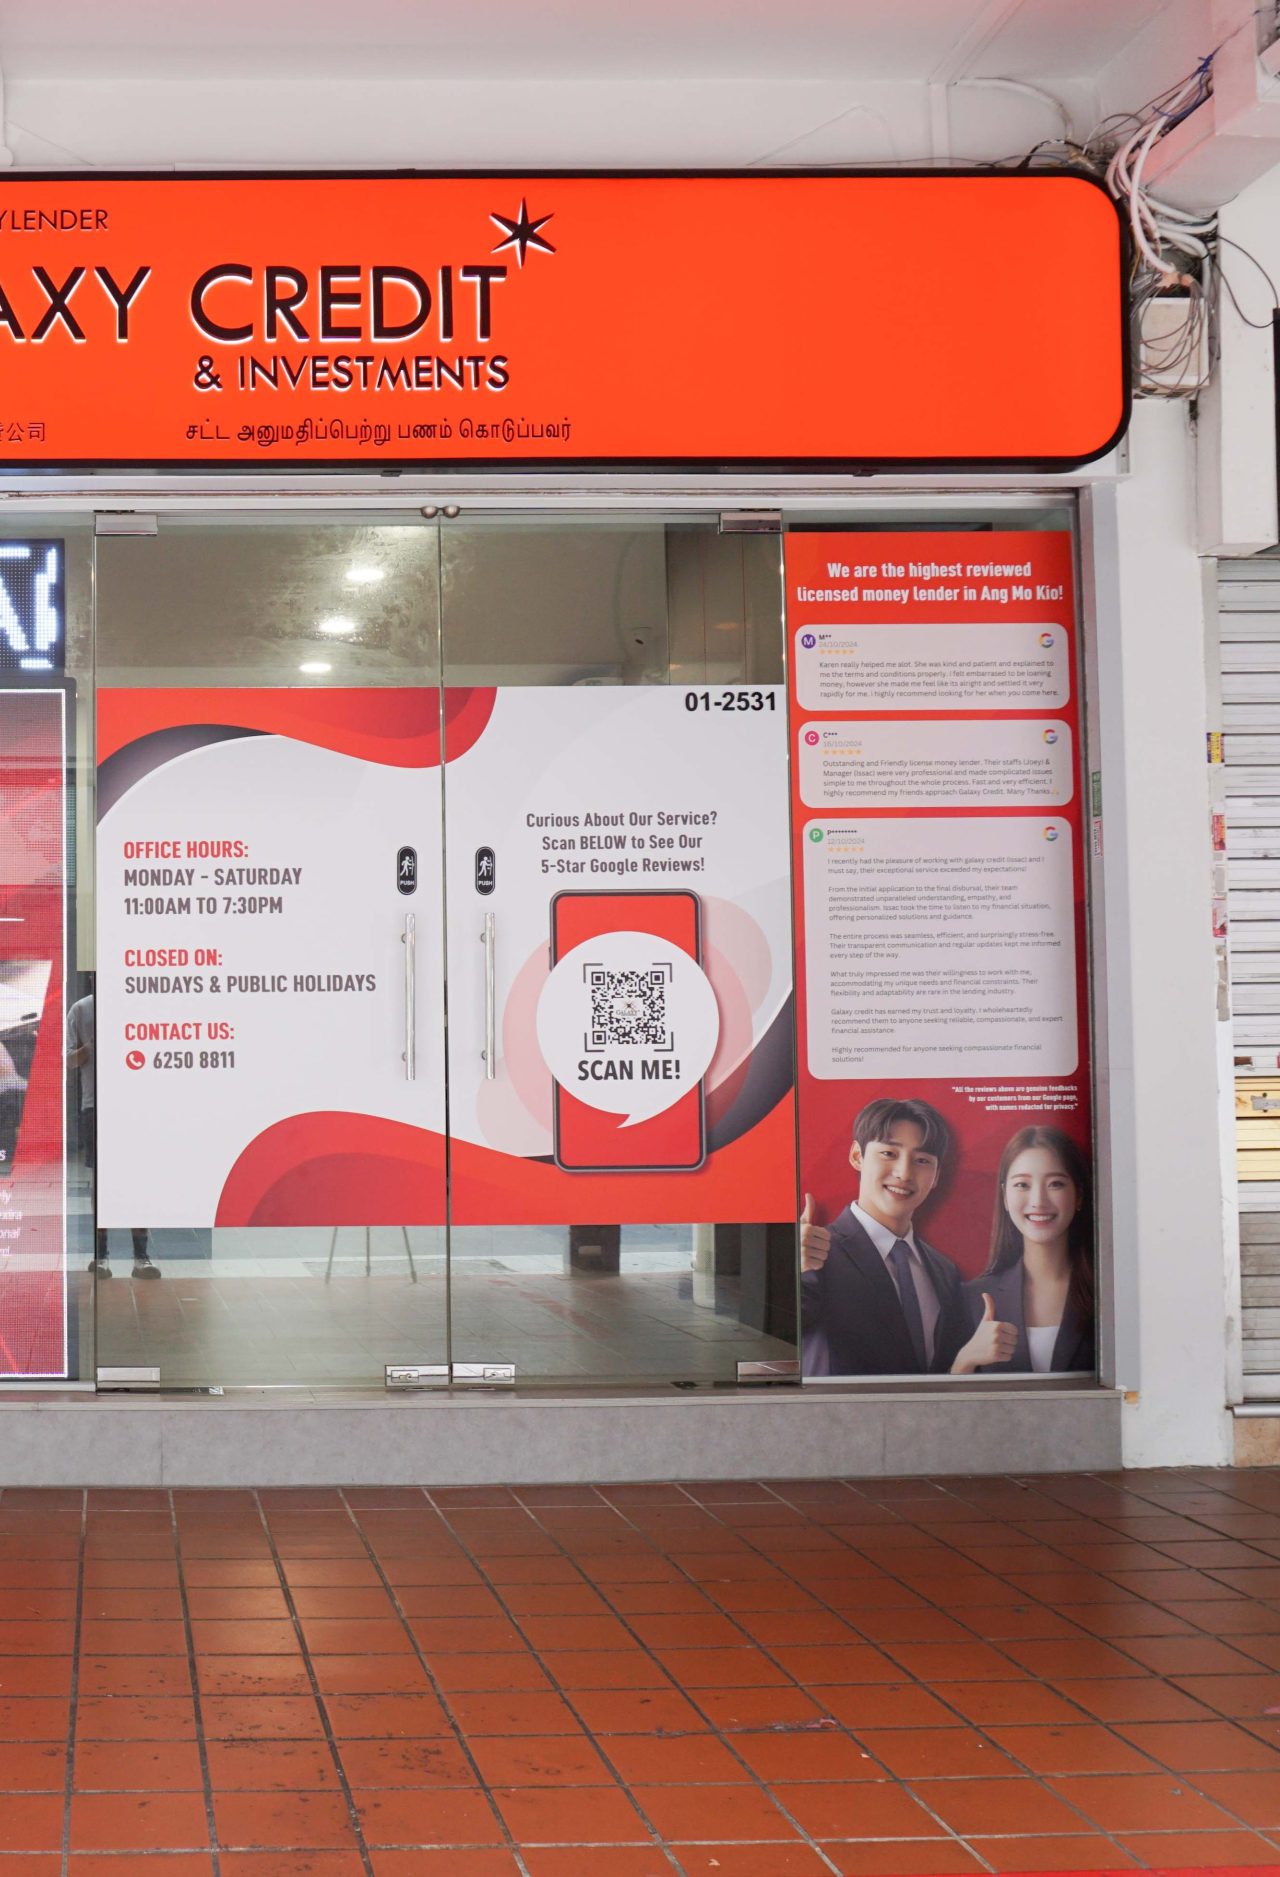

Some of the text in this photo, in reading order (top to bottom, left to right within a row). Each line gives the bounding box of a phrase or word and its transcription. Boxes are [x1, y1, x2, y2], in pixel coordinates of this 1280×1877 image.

[190, 263, 508, 342] CREDIT
[193, 354, 510, 390] & INVESTMENTS
[185, 417, 572, 446] சட்ட அனுமதிப்பெற்று பணம் கொடுப்பவர்
[827, 562, 1032, 579] We are the highest reviewed
[797, 585, 1064, 604] licensed money lender in Ang Mo Kio!
[685, 691, 776, 712] 01-2531
[526, 810, 718, 827] Curious About Our Service?
[124, 840, 249, 858] OFFICE HOURS:
[542, 834, 703, 850] Scan BELOW to See Our
[541, 857, 705, 875] 5-Star Google Reviews!
[124, 868, 195, 886] MONDAY
[214, 868, 302, 885] SATURDAY
[124, 897, 283, 915] 11:00AM TO 7:30PM
[125, 949, 222, 967] CLOSED ON:
[125, 974, 376, 994] SUNDAYS & PUBLIC HOLIDAYS
[125, 1022, 235, 1041] CONTACT US:
[153, 1051, 235, 1069] 6250 8811
[578, 1060, 680, 1081] SCAN ME!
